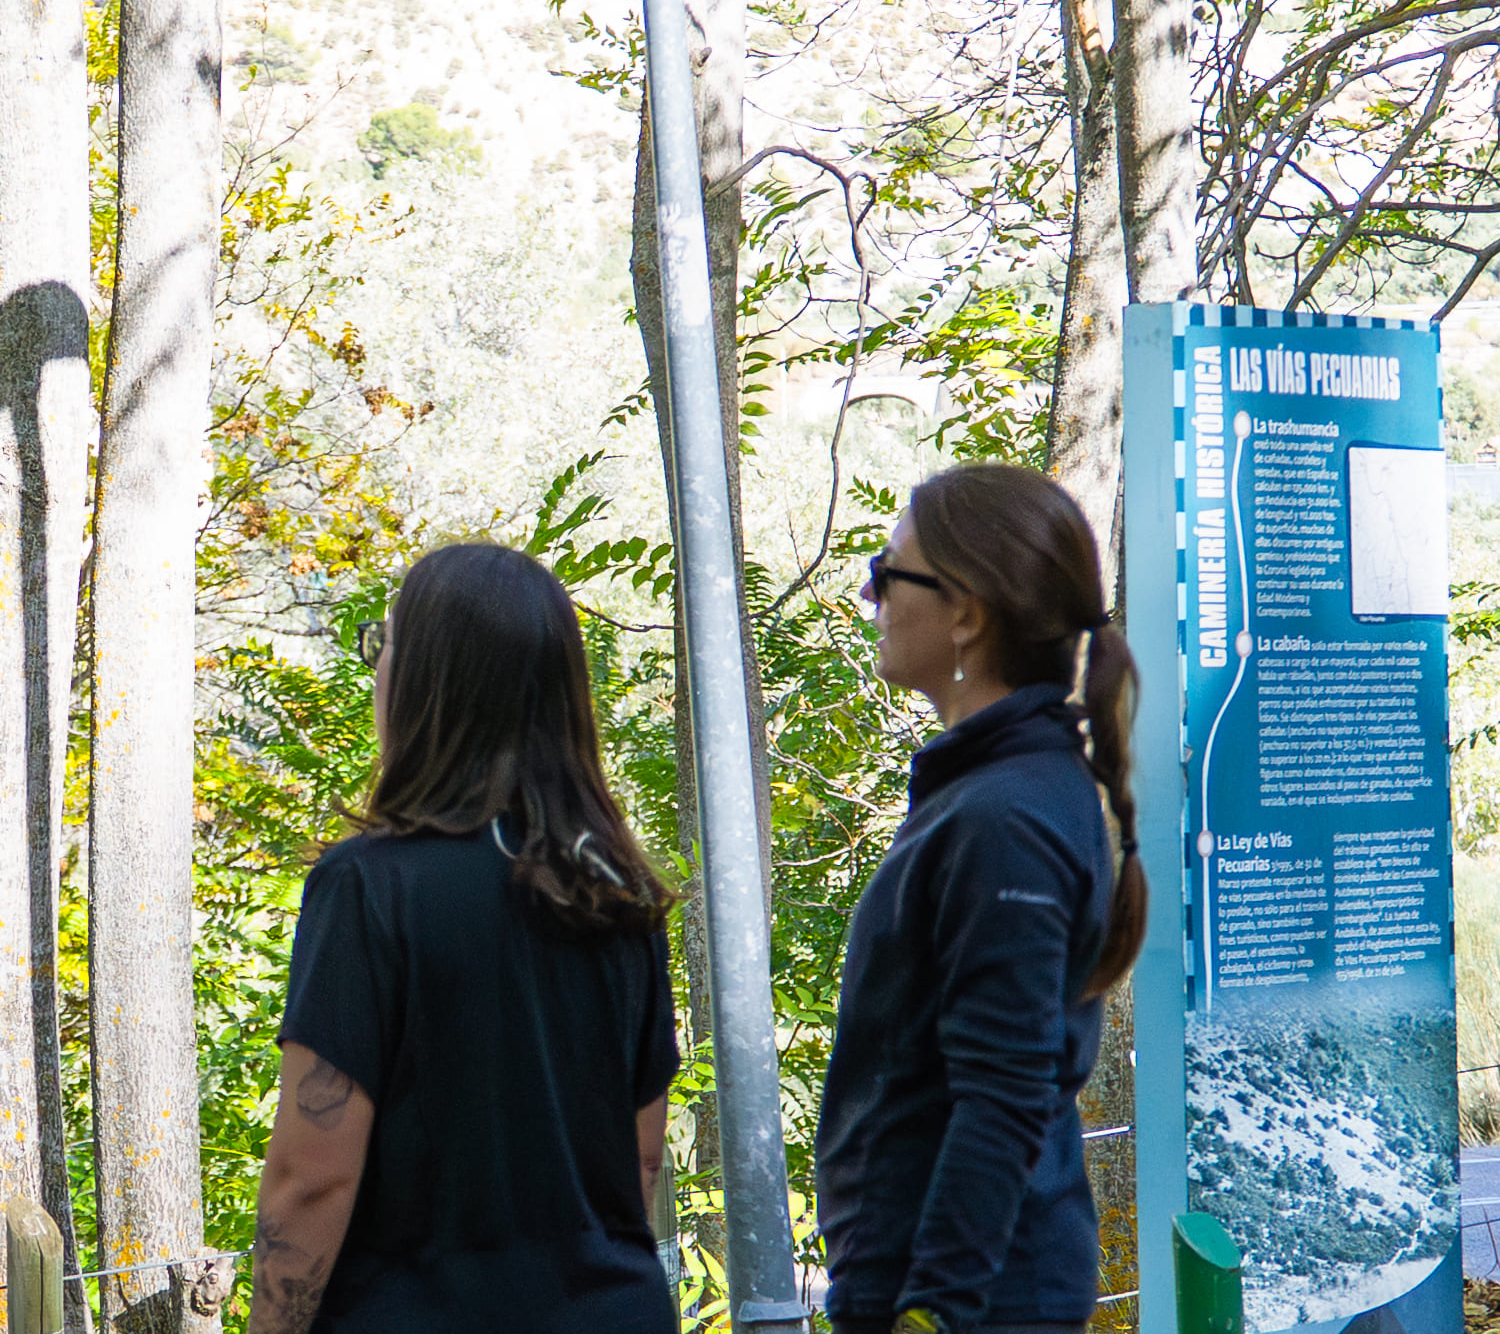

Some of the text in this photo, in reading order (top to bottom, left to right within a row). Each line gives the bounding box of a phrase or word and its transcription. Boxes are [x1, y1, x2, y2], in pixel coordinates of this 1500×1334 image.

[1230, 343, 1400, 401] LAS VÍAS PECUARIAS
[1253, 417, 1340, 438] La trashumancia
[1191, 345, 1227, 668] CAMINERÍA HISTÓRICA
[1257, 635, 1270, 652] La
[1272, 635, 1310, 652] cabaña
[1217, 830, 1293, 854] La Ley de Vías
[1217, 855, 1270, 873] Pecuarias
